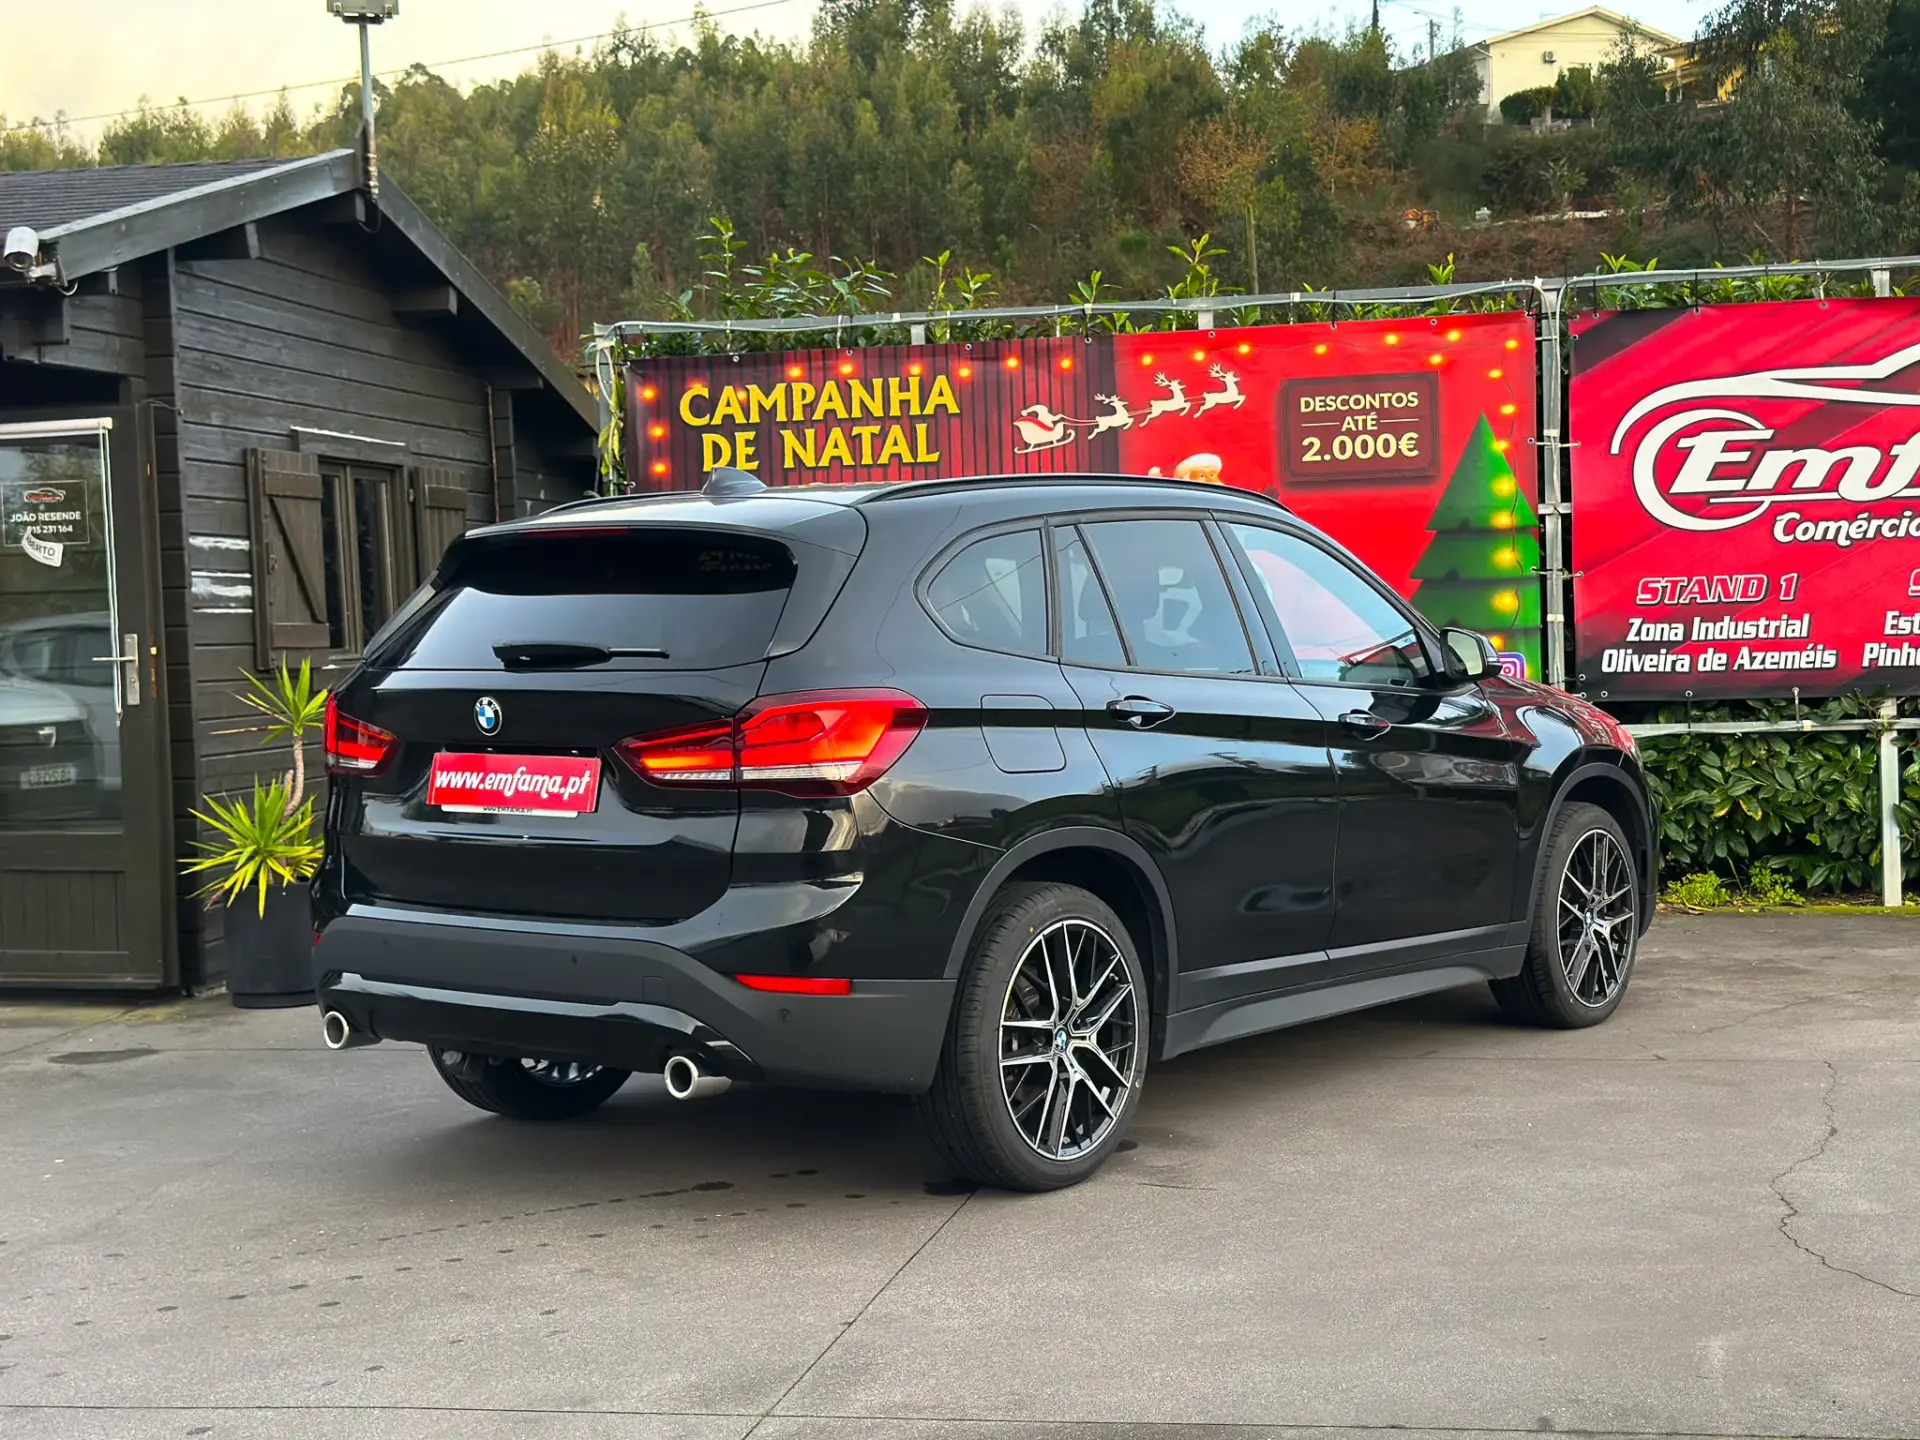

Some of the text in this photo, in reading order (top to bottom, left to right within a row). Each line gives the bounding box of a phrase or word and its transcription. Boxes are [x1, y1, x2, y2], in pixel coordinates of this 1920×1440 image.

[679, 374, 961, 427] CAMPANHA
[1300, 391, 1419, 413] DESCONTOS
[1341, 412, 1378, 431] ATÉ
[702, 423, 940, 472] DE NATAL
[1301, 432, 1420, 462] 2.000€
[10, 510, 82, 522] JOÃO RESENDE
[1636, 572, 1799, 605] STAND 1
[1626, 613, 1811, 642] Zona Industrial
[1601, 643, 1838, 673] Oliveira de Azeméis
[435, 765, 591, 800] www.emfama.pt
